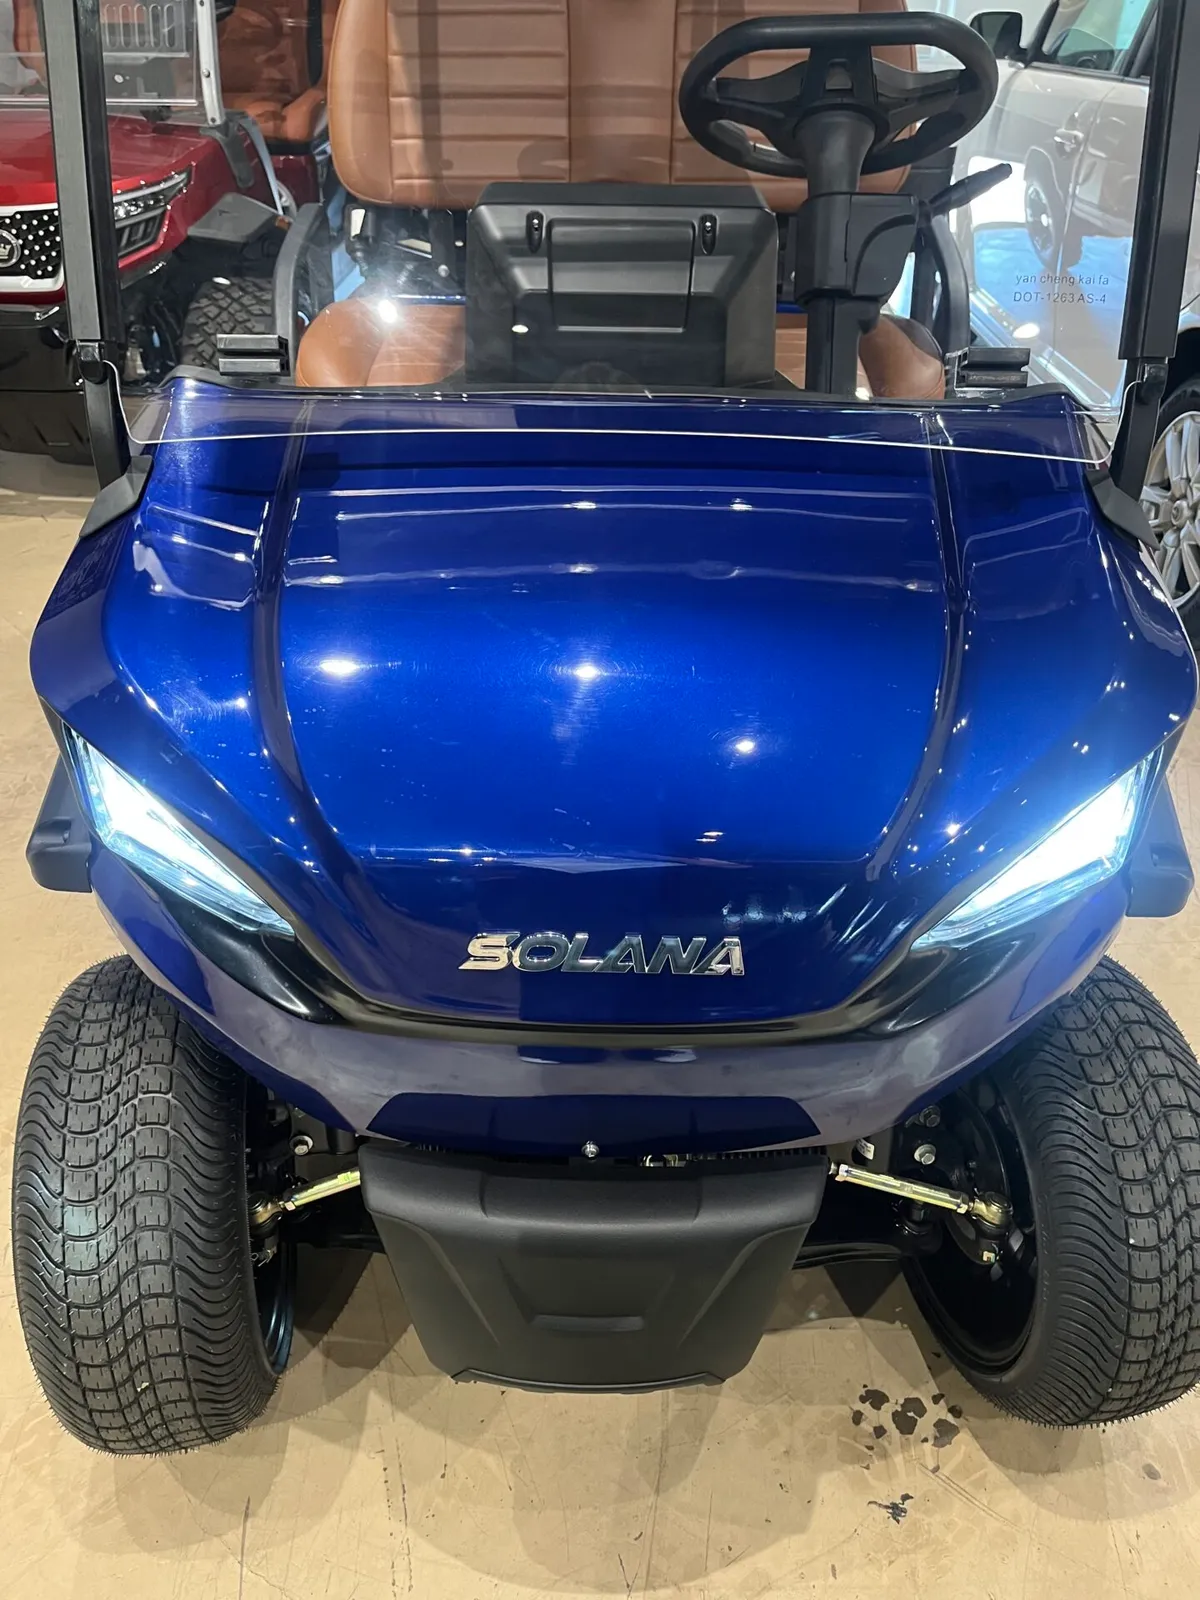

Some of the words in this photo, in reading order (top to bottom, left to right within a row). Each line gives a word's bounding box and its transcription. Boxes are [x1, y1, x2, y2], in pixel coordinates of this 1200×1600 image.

[1015, 275, 1037, 286] yan
[1040, 273, 1075, 286] cheng
[1078, 274, 1096, 286] kai
[1098, 274, 1110, 286] fa
[1013, 291, 1075, 303] DOT-1263
[1077, 292, 1107, 304] AS-4
[458, 931, 745, 976] SOLANA
